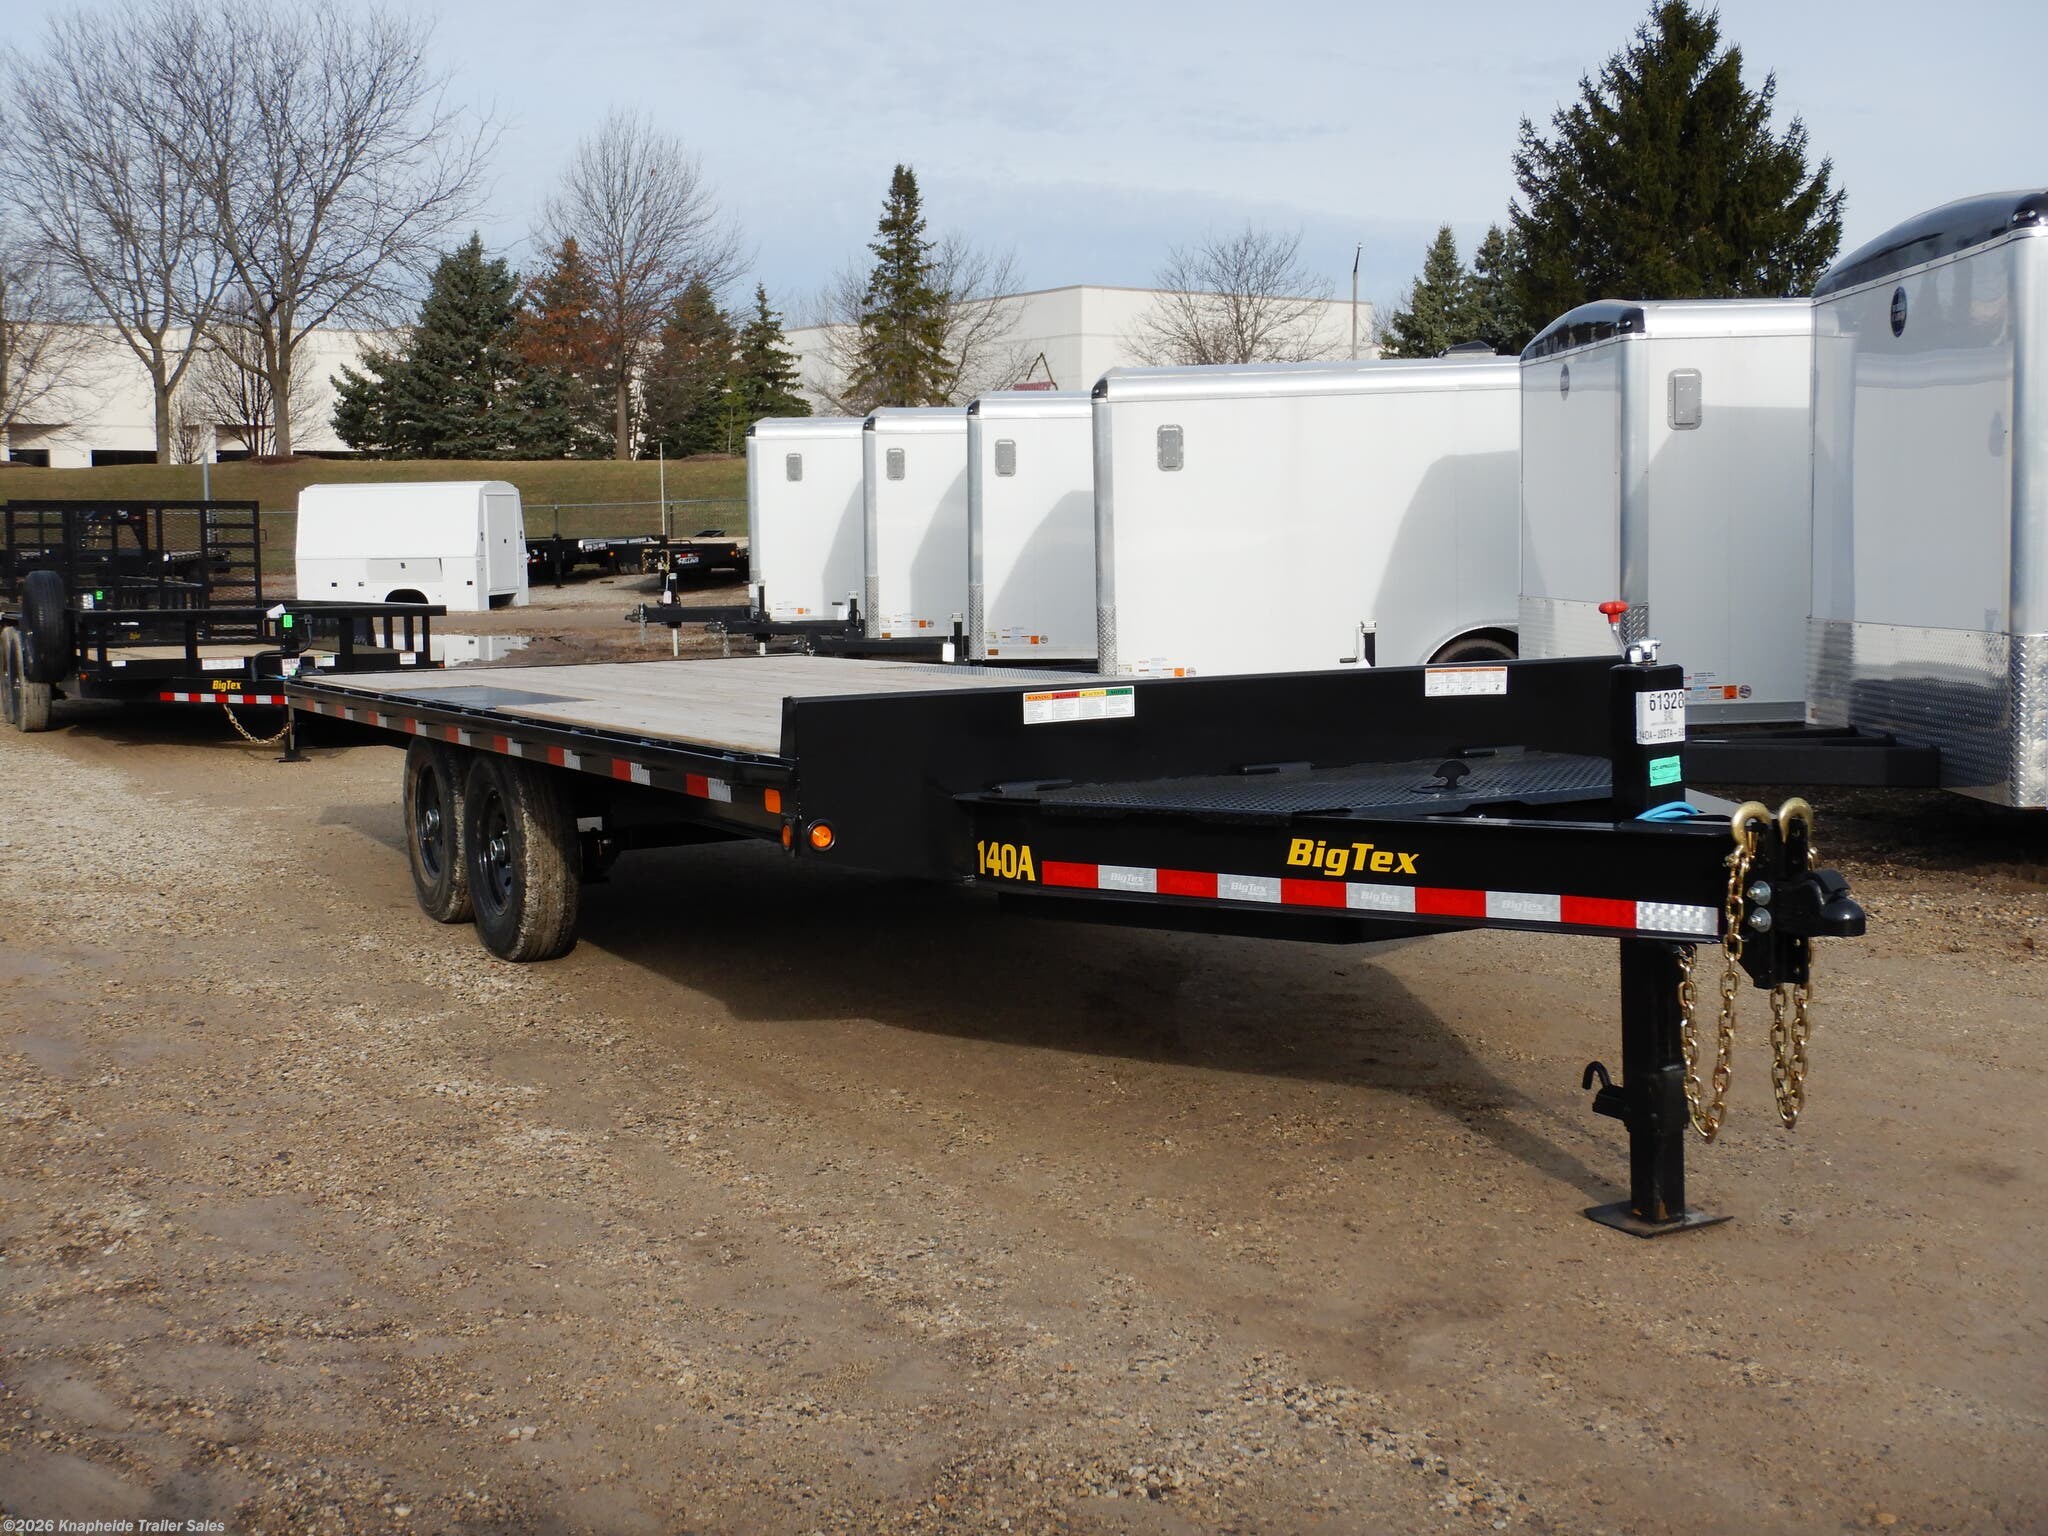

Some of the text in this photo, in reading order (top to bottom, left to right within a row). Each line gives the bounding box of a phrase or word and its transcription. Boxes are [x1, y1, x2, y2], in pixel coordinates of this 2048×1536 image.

[212, 680, 241, 692] BigTex
[977, 840, 1036, 881] 140A
[1286, 838, 1419, 876] BigTex
